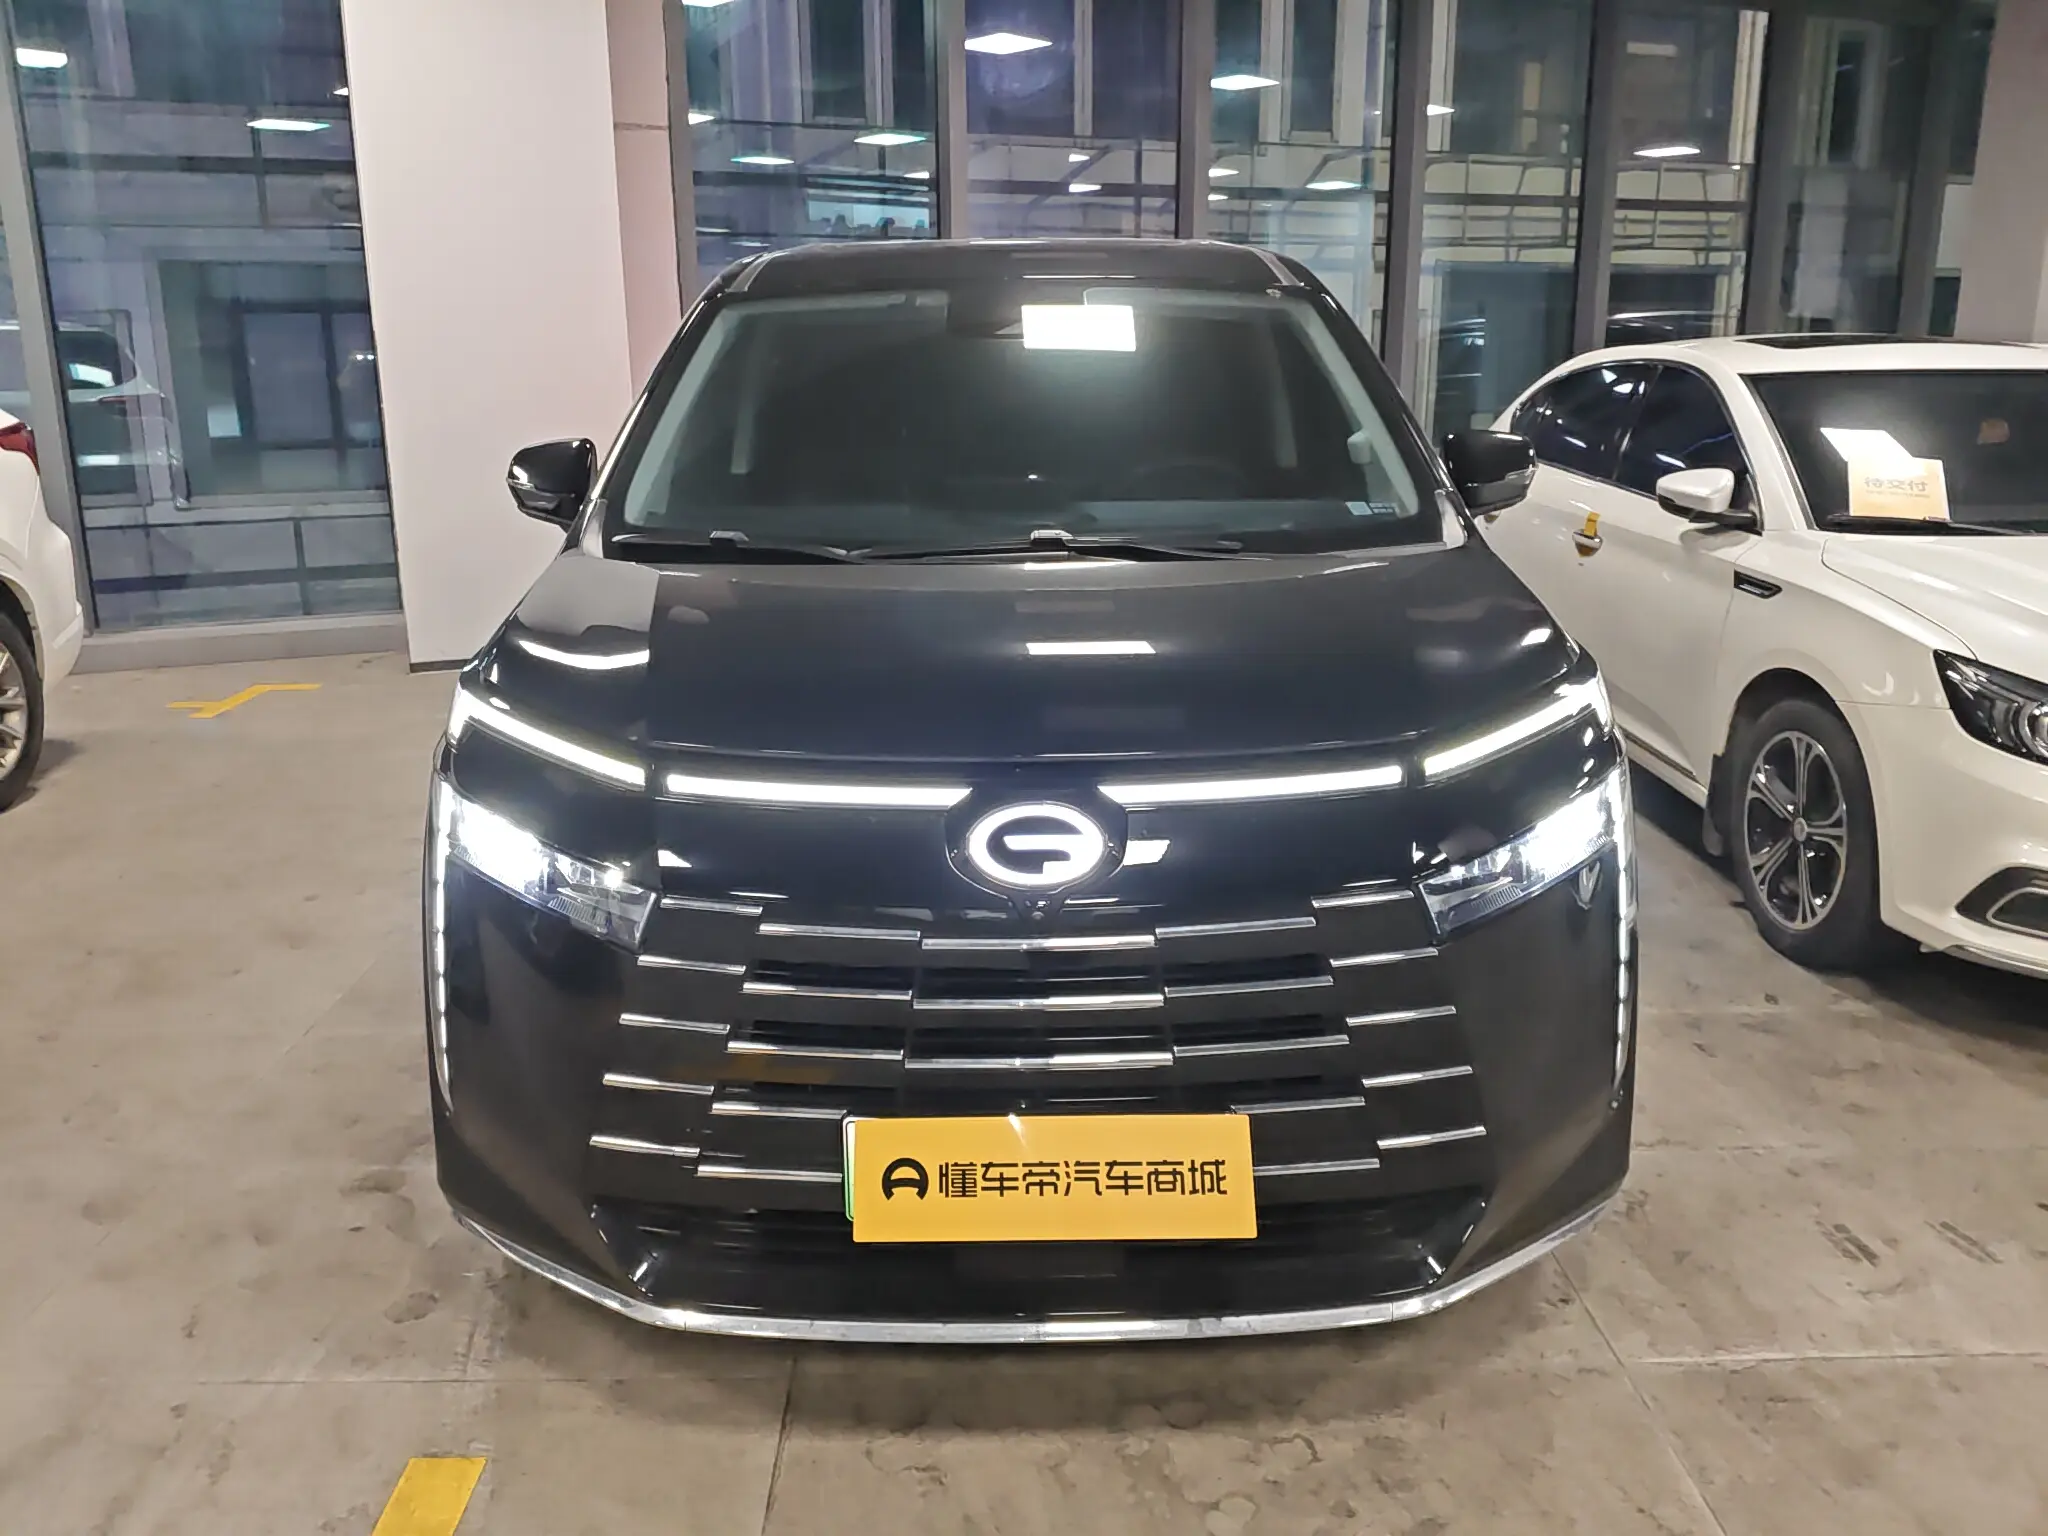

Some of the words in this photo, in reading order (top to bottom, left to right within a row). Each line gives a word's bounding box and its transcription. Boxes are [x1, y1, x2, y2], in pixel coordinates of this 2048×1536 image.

[1864, 477, 1928, 492] 待交付
[938, 1159, 1228, 1198] 懂车帝汽车商城
